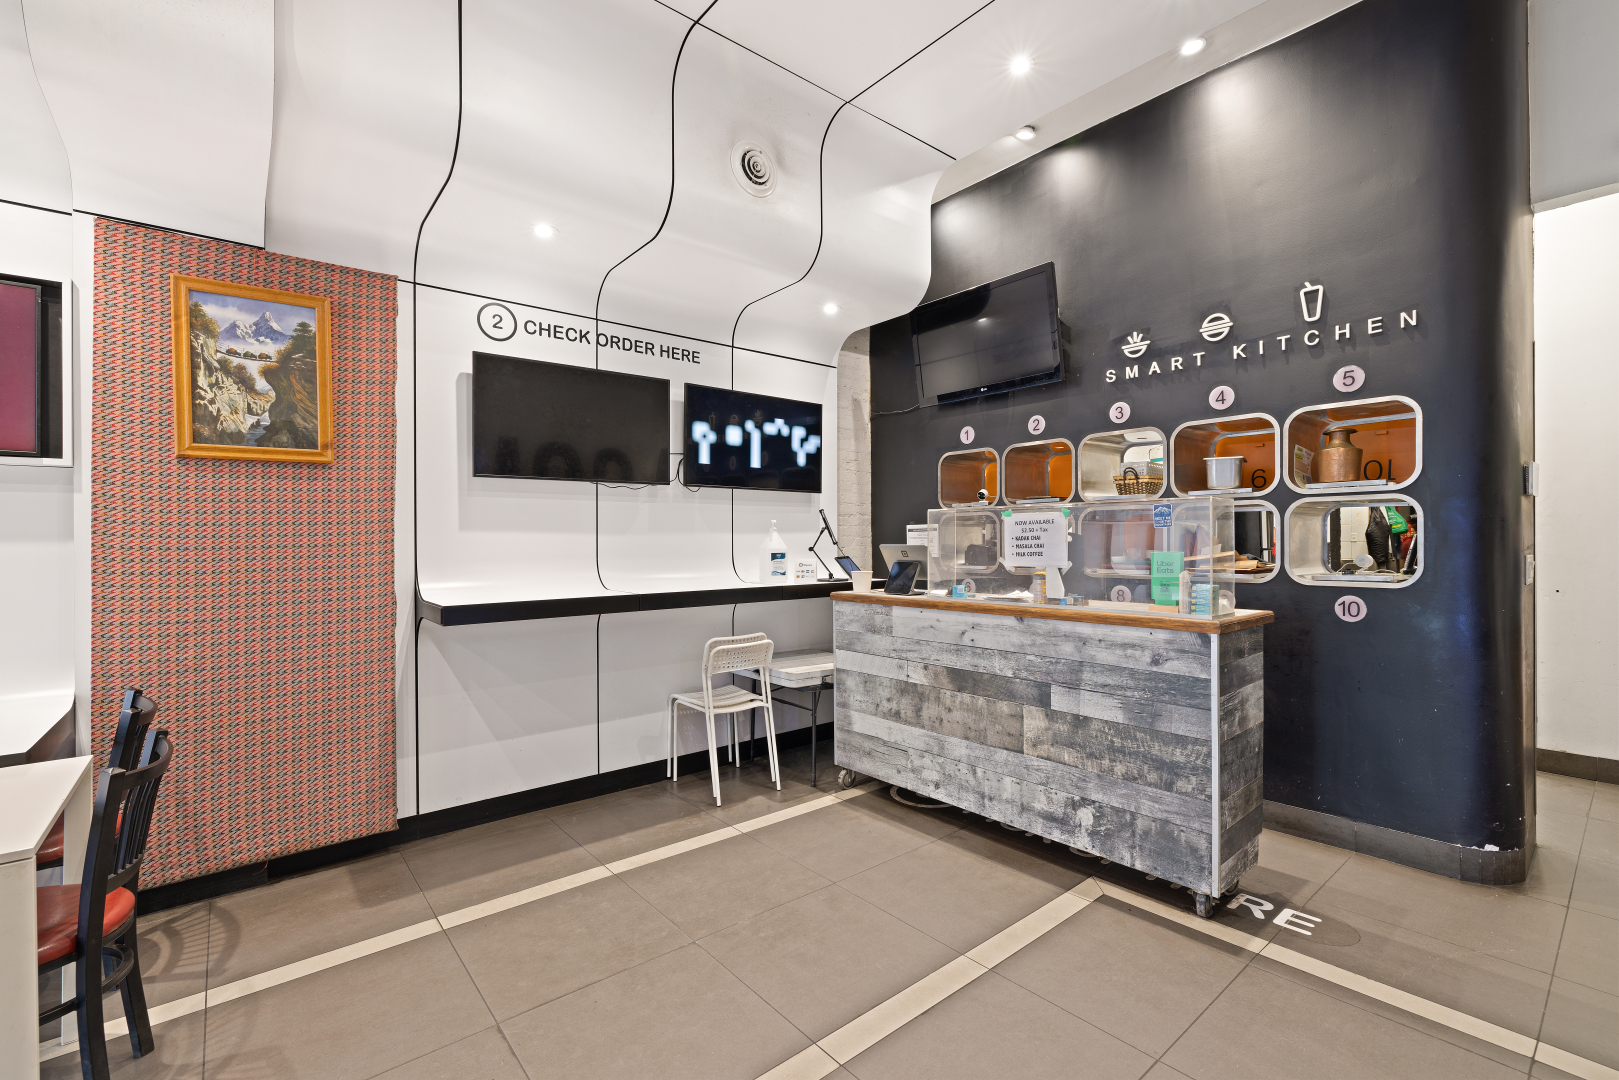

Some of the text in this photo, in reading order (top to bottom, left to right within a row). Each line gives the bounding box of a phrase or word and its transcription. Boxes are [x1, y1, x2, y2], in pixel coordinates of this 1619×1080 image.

[492, 313, 701, 364] 2 CHECK ORDER HERE
[1105, 309, 1418, 383] SMART KITCHEN
[1342, 369, 1356, 387] 5
[1215, 390, 1227, 406] 4
[1114, 406, 1124, 420] 3
[1032, 418, 1041, 432] 2
[963, 430, 970, 441] 1
[1116, 589, 1125, 602] 8
[1337, 600, 1361, 619] 10
[1226, 892, 1323, 936] RE
